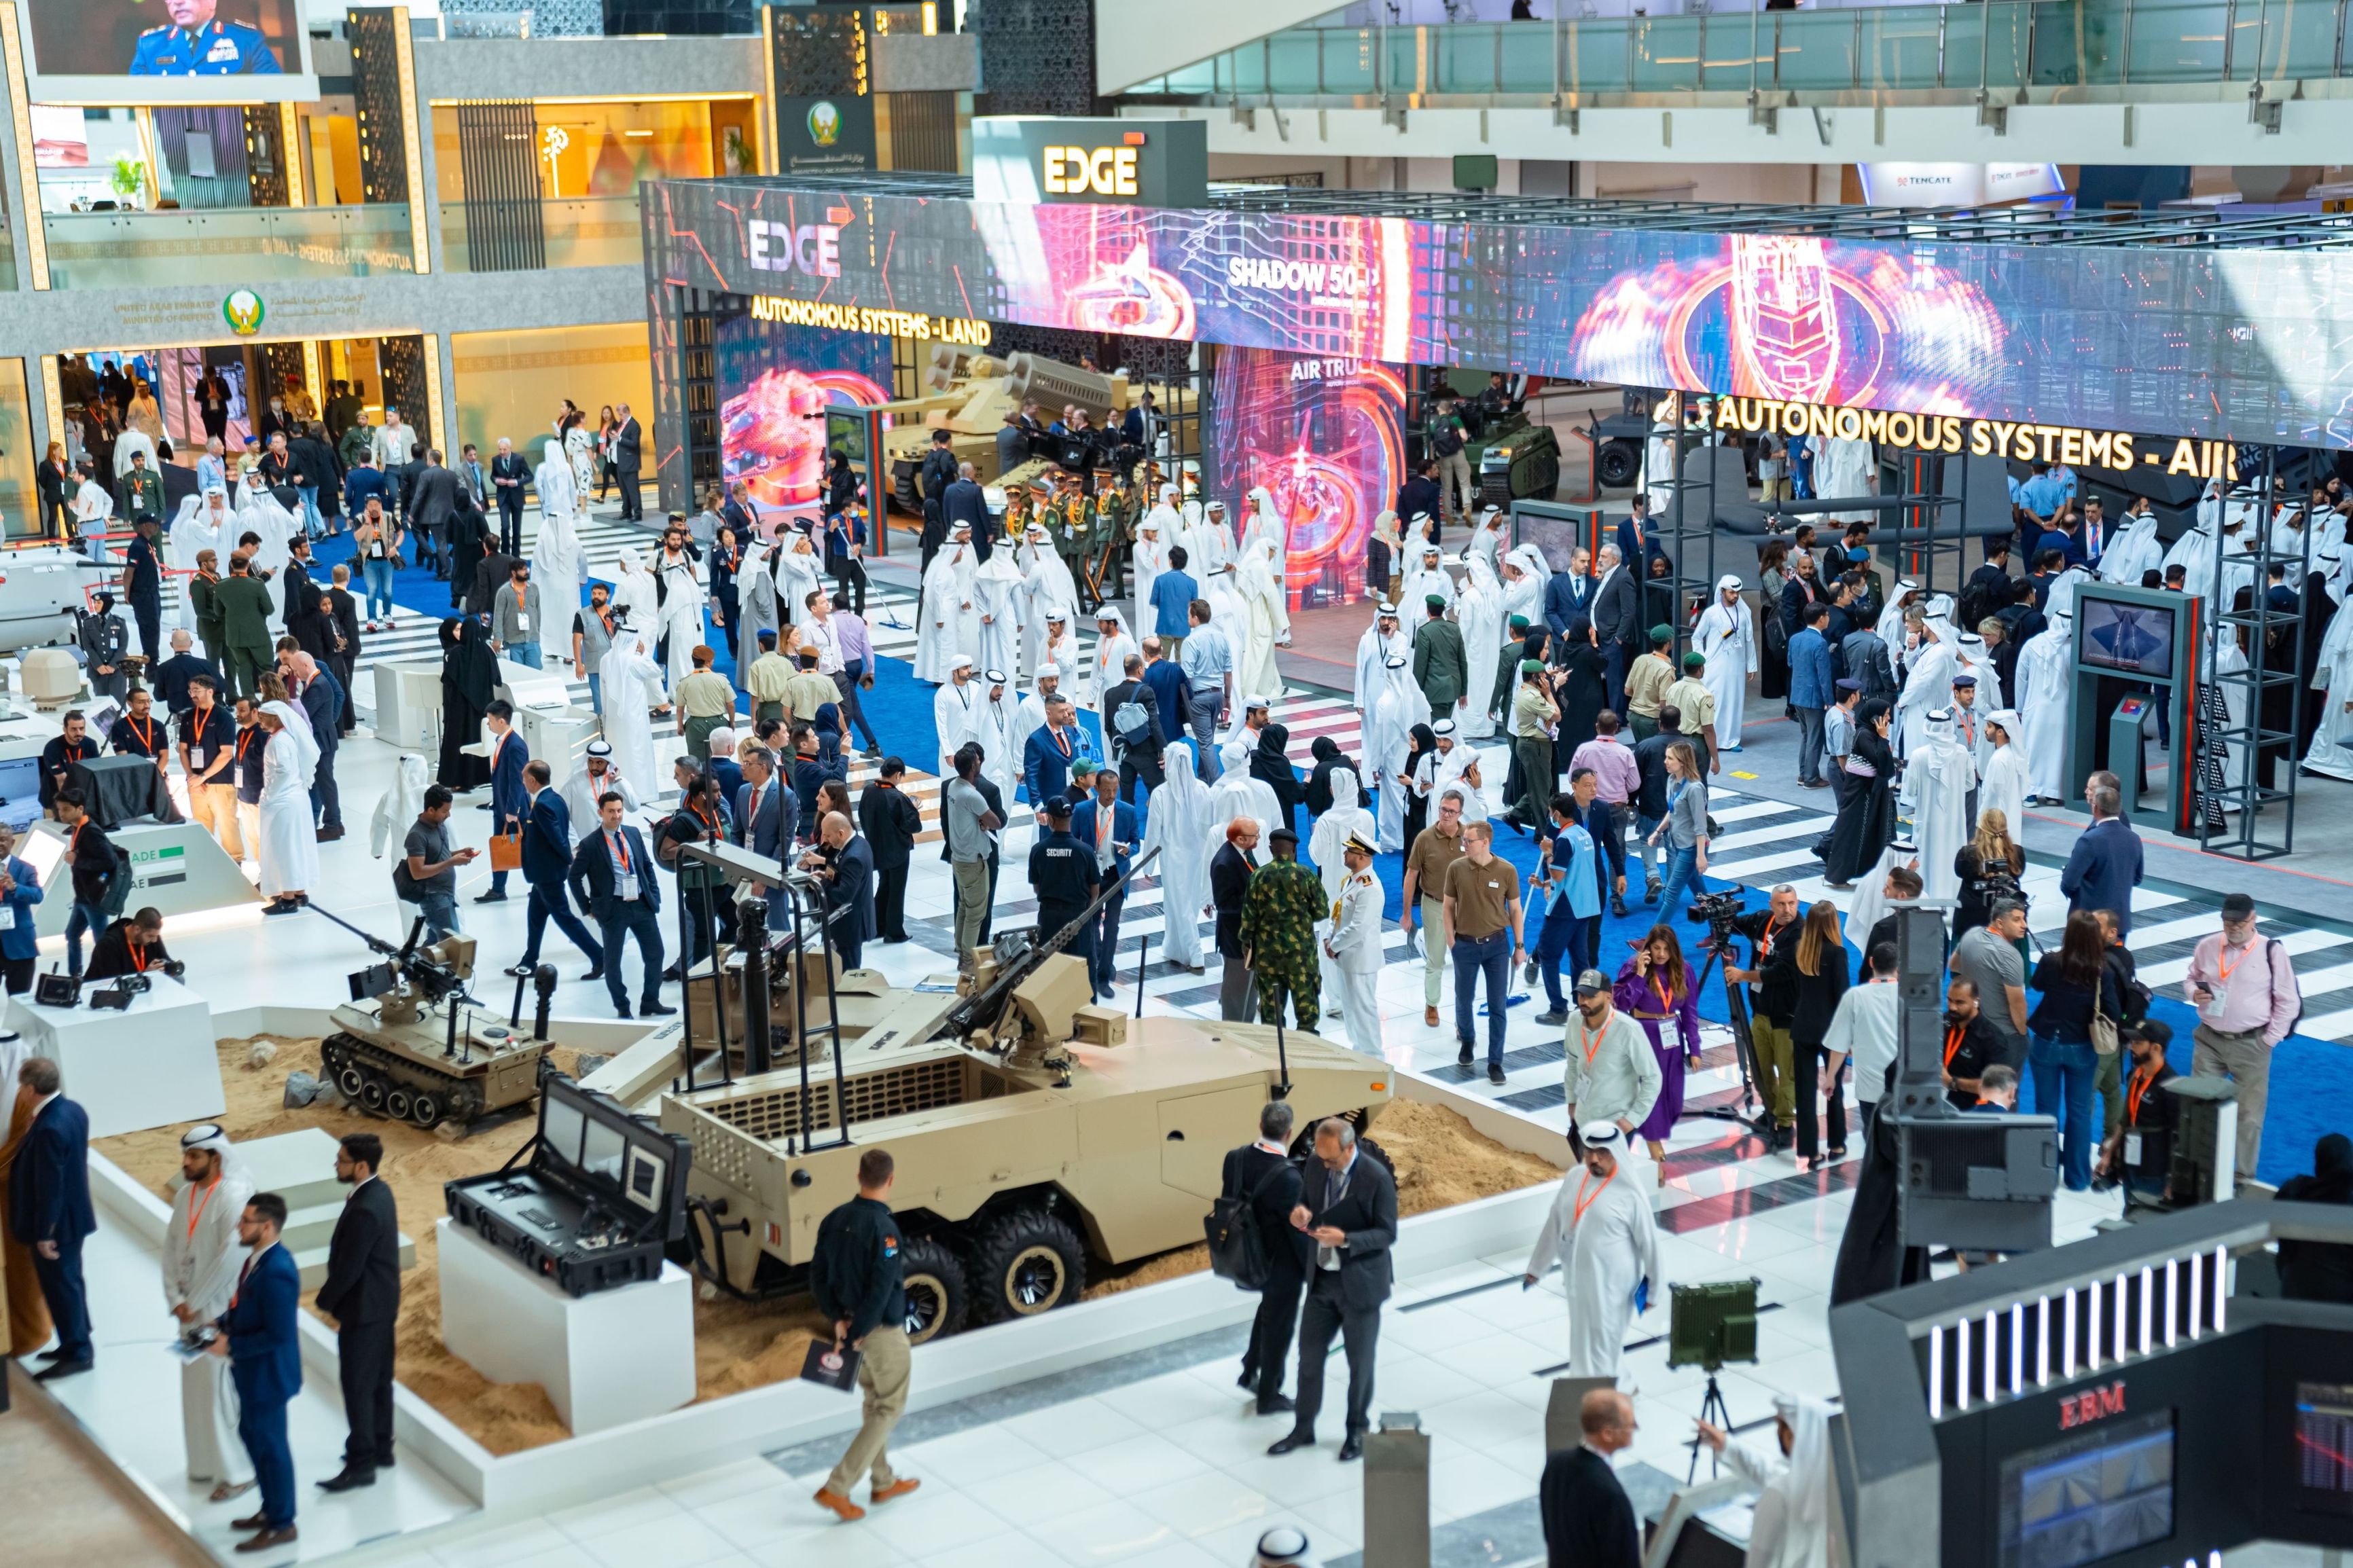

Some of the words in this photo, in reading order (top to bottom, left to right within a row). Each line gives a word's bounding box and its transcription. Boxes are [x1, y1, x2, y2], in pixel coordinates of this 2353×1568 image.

[1043, 145, 1137, 195] EDGE
[749, 219, 840, 277] EDGE
[1229, 257, 1326, 292] SHADOW
[751, 295, 859, 331] AUTONOMOUS
[860, 307, 931, 340] SYSTEMS
[940, 316, 991, 346] LAND
[1291, 360, 1321, 380] AIR
[1716, 396, 1962, 453] AUTONOMOUS
[1971, 419, 2134, 471] SYSTEMS
[2144, 453, 2159, 464] -
[2167, 438, 2238, 481] AIR
[131, 850, 156, 862] ADE
[1046, 848, 1072, 857] SECURITY
[130, 879, 145, 889] AE
[2058, 1380, 2126, 1430] EBM
